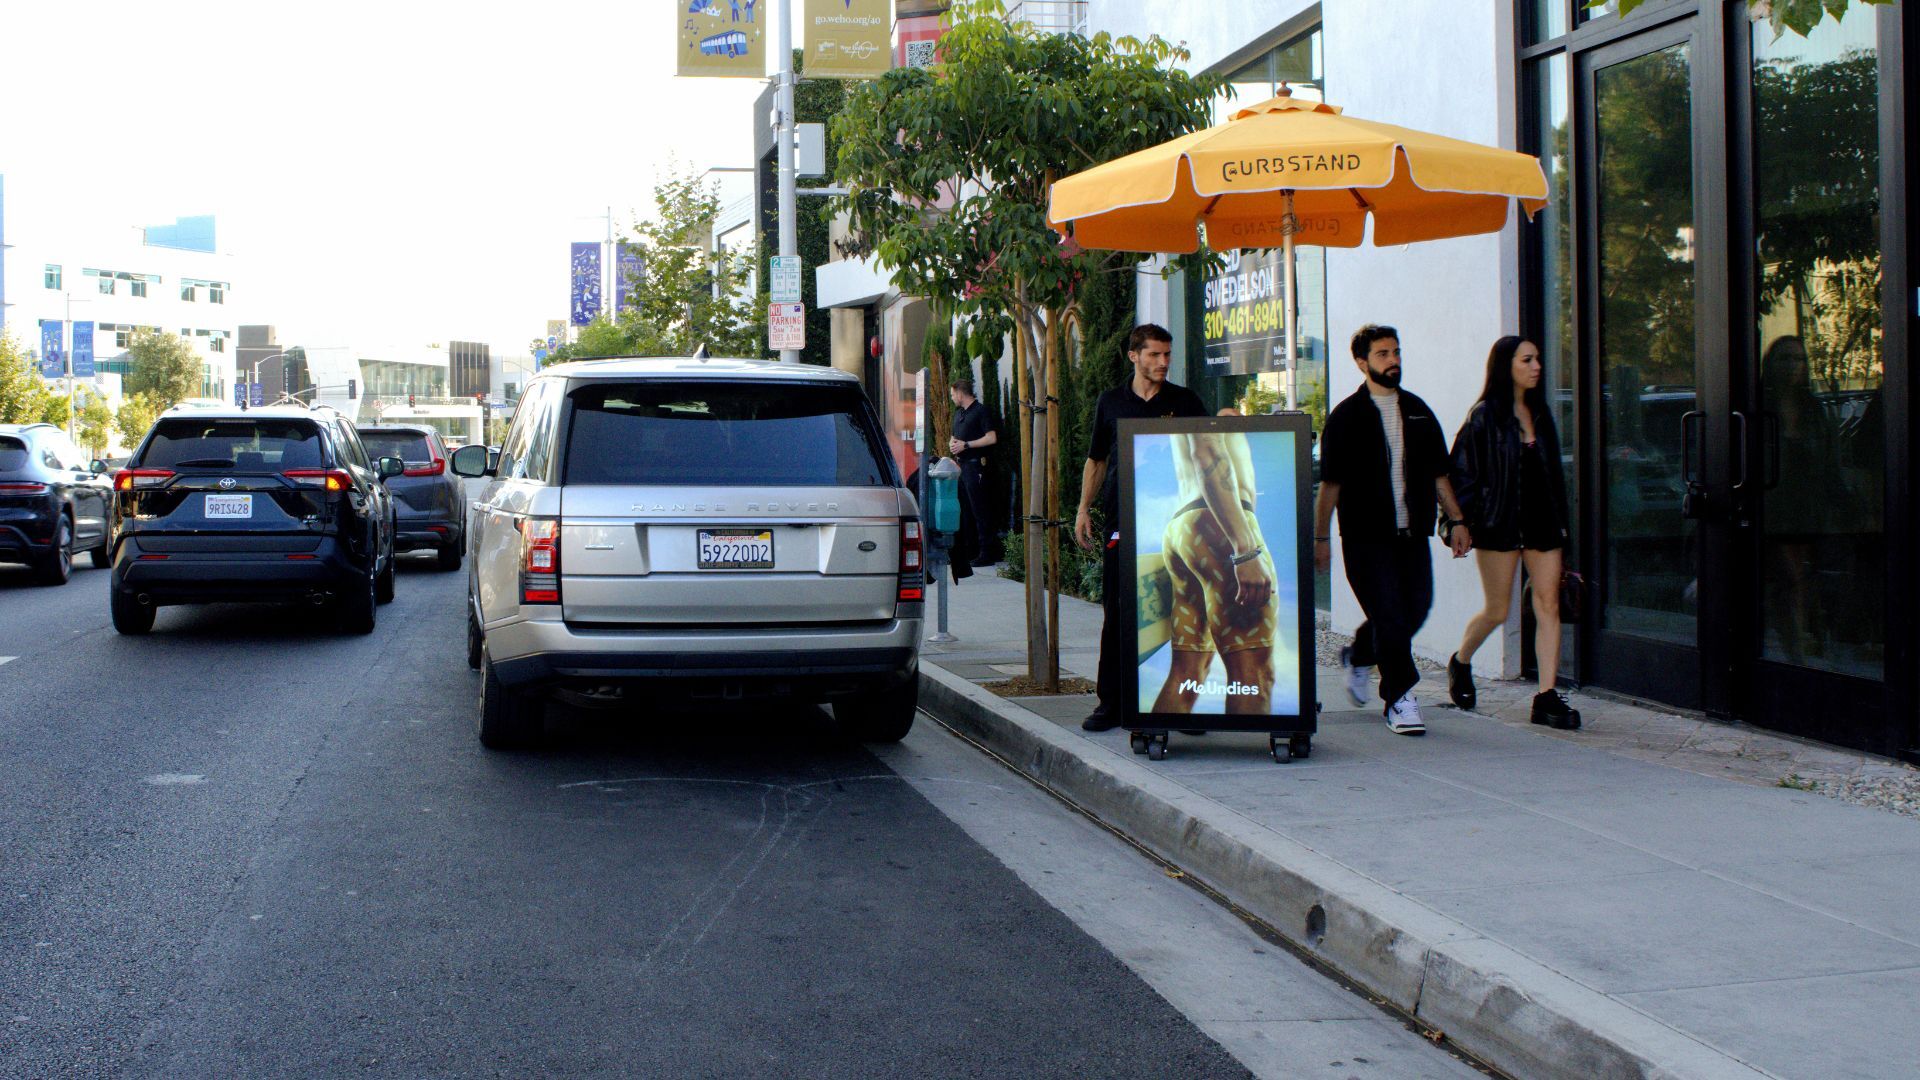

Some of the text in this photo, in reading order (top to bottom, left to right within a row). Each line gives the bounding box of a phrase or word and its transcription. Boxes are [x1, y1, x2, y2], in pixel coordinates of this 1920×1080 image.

[815, 14, 881, 26] go.weho.org/40
[1222, 154, 1361, 182] CURBSTAND
[773, 257, 779, 268] 2
[1204, 266, 1275, 309] SWEDELSON
[770, 304, 781, 316] NO
[771, 316, 802, 326] PARKING
[1204, 299, 1284, 340] 310-461-8941
[209, 503, 250, 515] 9RIS428
[631, 503, 840, 512] RANGE ROVER
[702, 544, 769, 562] 59220D2
[1178, 679, 1259, 695] MeUndies
